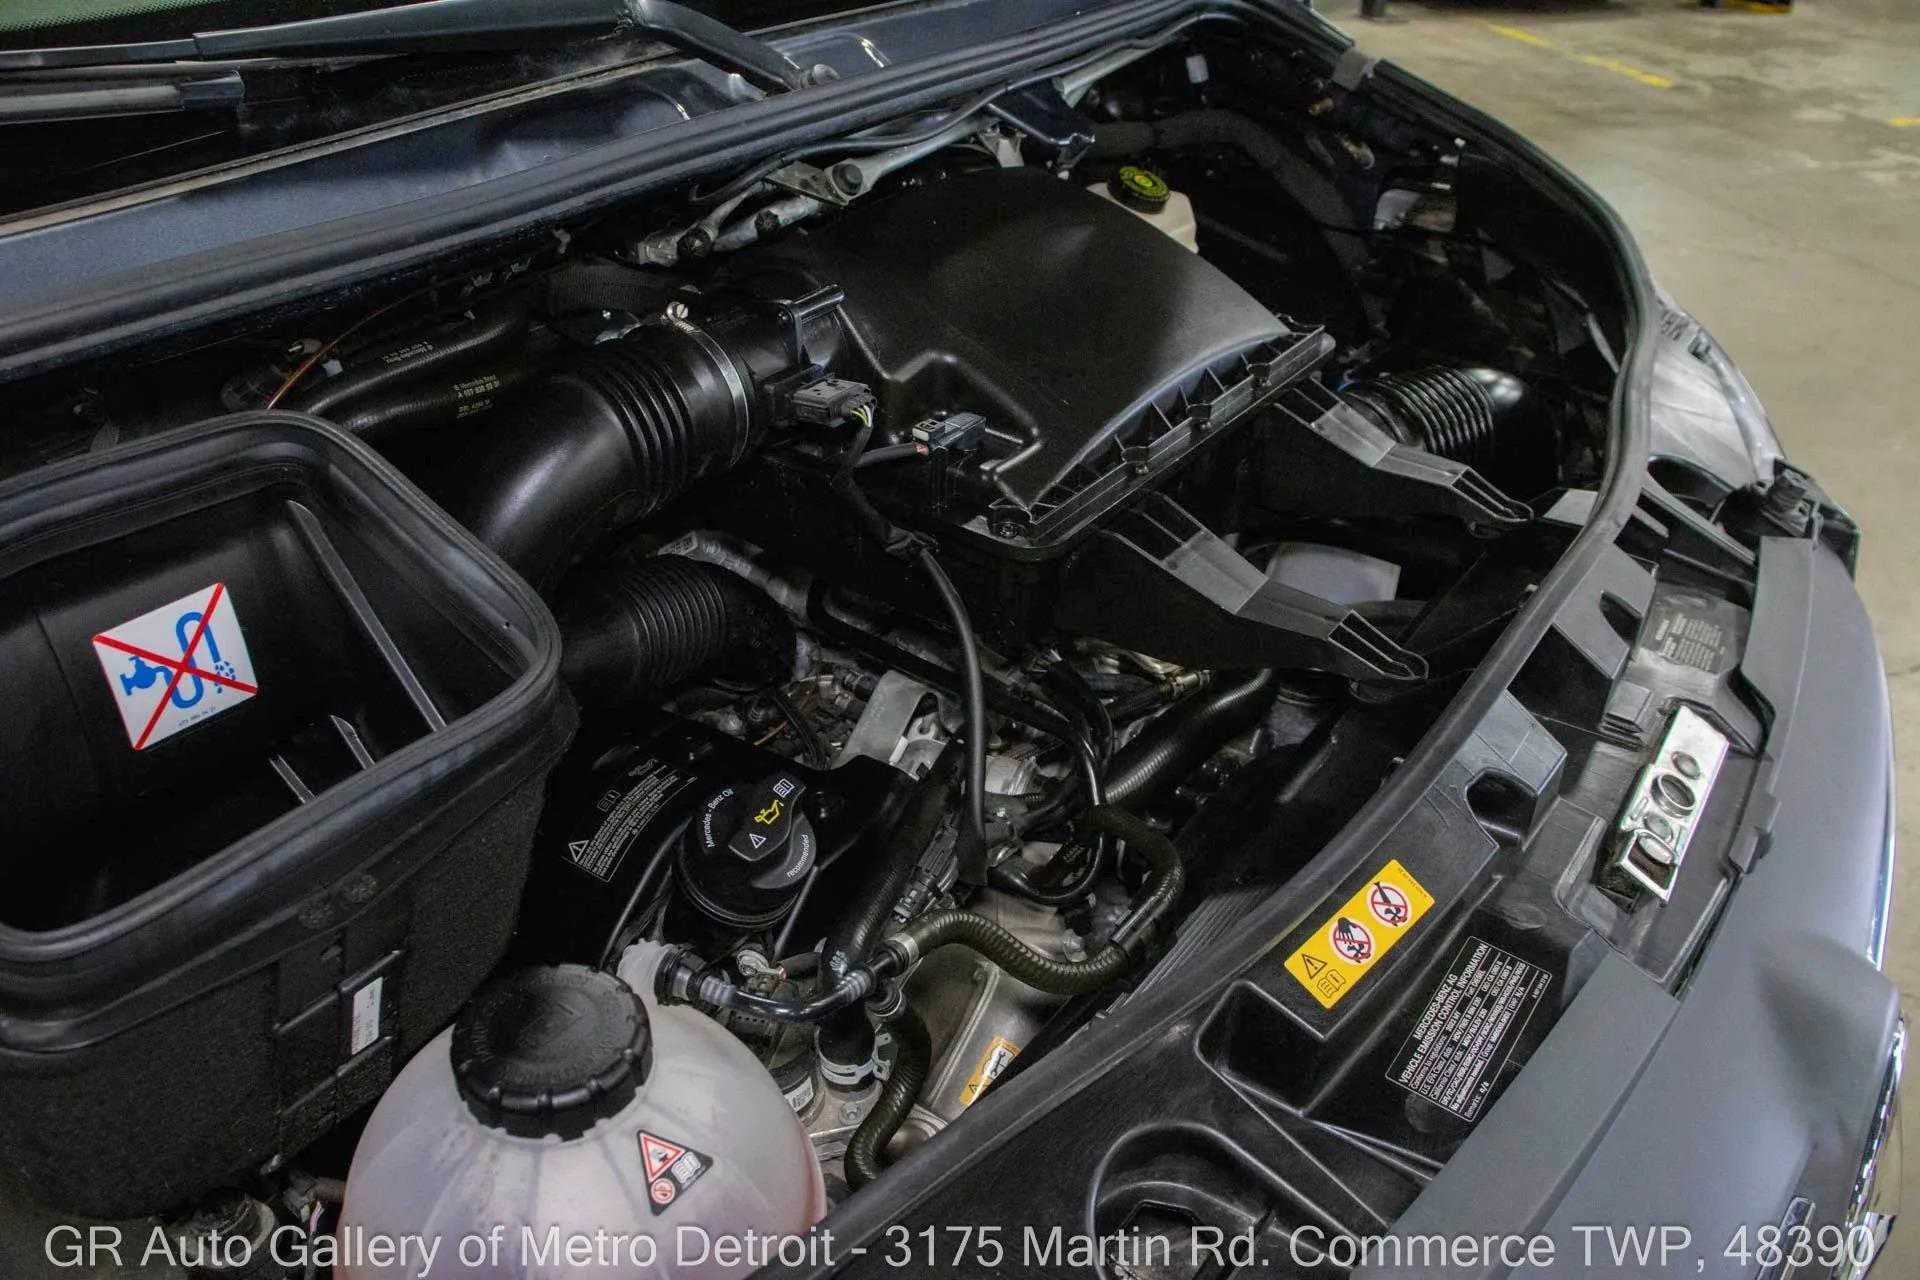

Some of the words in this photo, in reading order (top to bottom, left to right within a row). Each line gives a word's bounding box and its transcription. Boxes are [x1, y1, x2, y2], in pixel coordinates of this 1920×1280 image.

[707, 794, 725, 809] Benz
[722, 788, 734, 797] Oil
[702, 813, 715, 848] Mercedes
[786, 834, 810, 878] recommended
[1470, 968, 1486, 986] DIESEL
[1514, 987, 1525, 997] N/A
[1399, 1052, 1423, 1082] VEHICLE
[1417, 1019, 1443, 1054] EMISSION
[1438, 989, 1462, 1019] CONTROL
[1456, 944, 1488, 988] INFORMATION
[1413, 984, 1452, 1040] MERCEDES-BENZ
[1447, 974, 1457, 985] AG
[1410, 1064, 1428, 1089] Conforms
[1424, 1058, 1432, 1066] to
[1427, 1073, 1437, 1084] EPA
[1430, 1075, 1448, 1100] California
